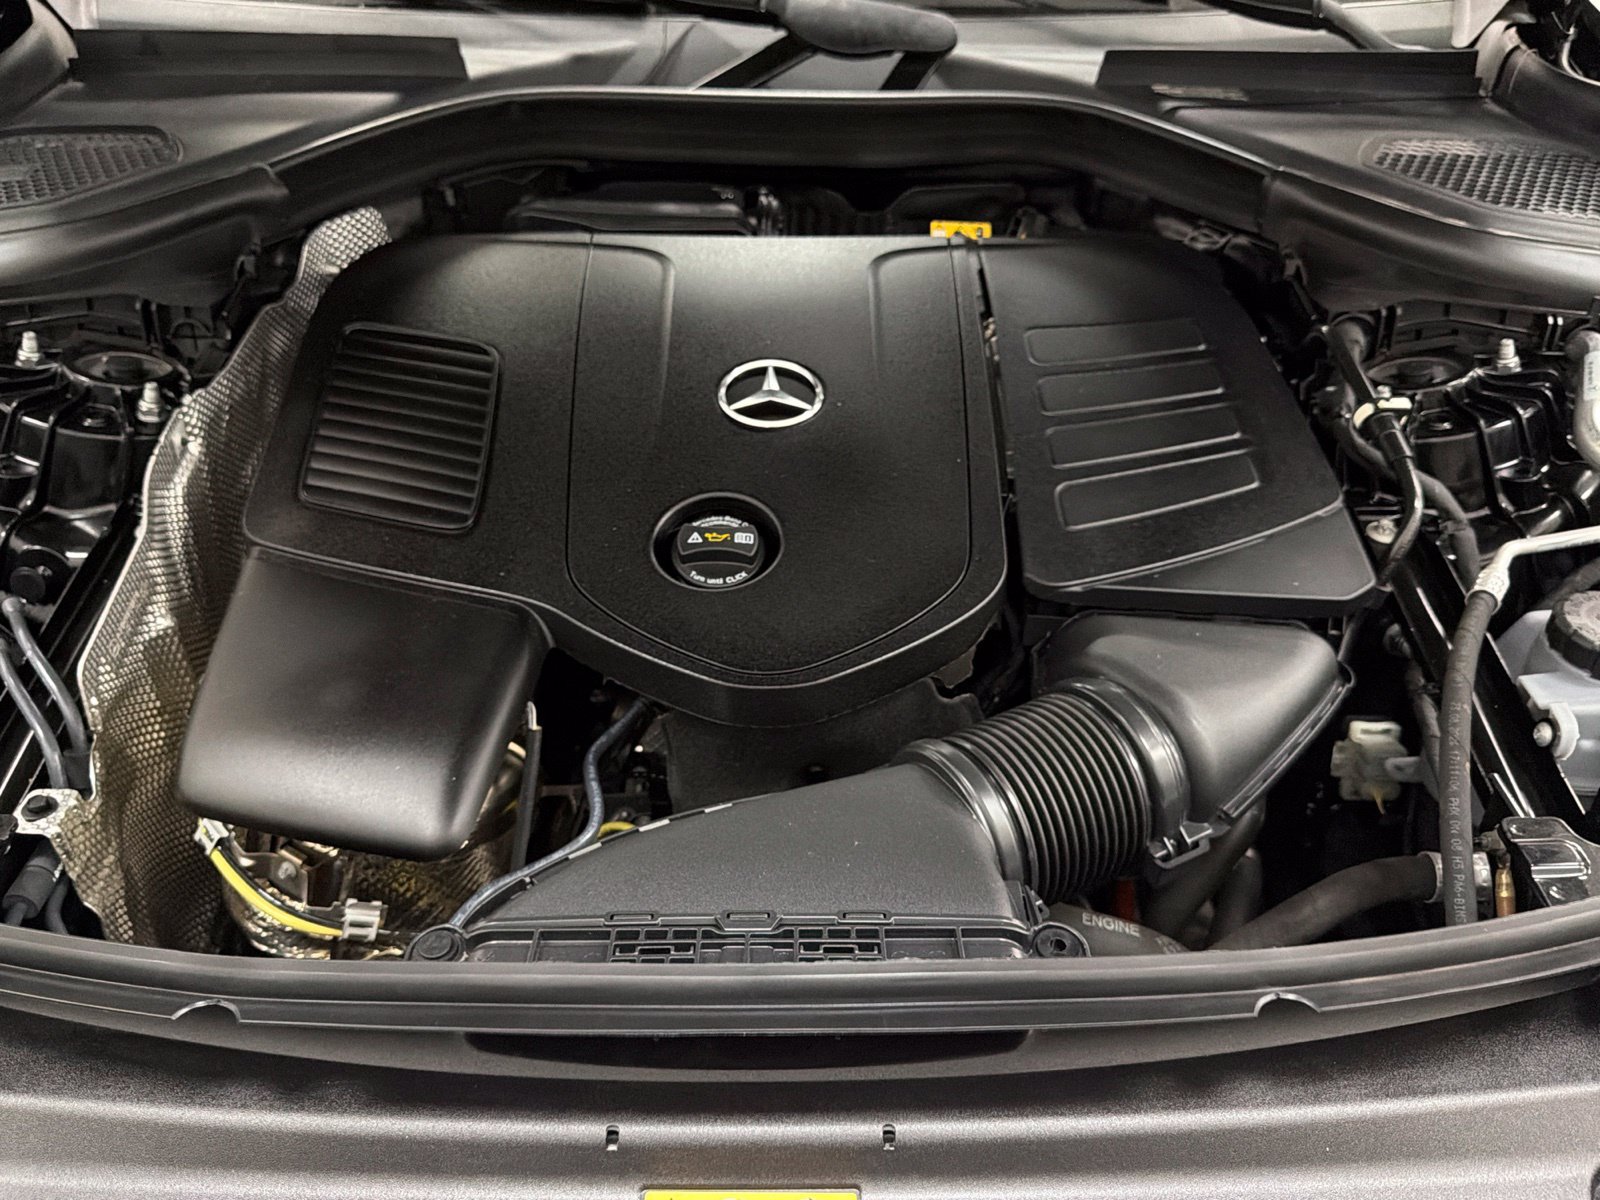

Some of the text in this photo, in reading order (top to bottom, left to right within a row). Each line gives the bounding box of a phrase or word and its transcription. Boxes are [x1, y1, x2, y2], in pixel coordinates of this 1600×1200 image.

[690, 570, 706, 582] Turn
[726, 571, 749, 584] CLICK
[1081, 911, 1141, 937] ENGINE
